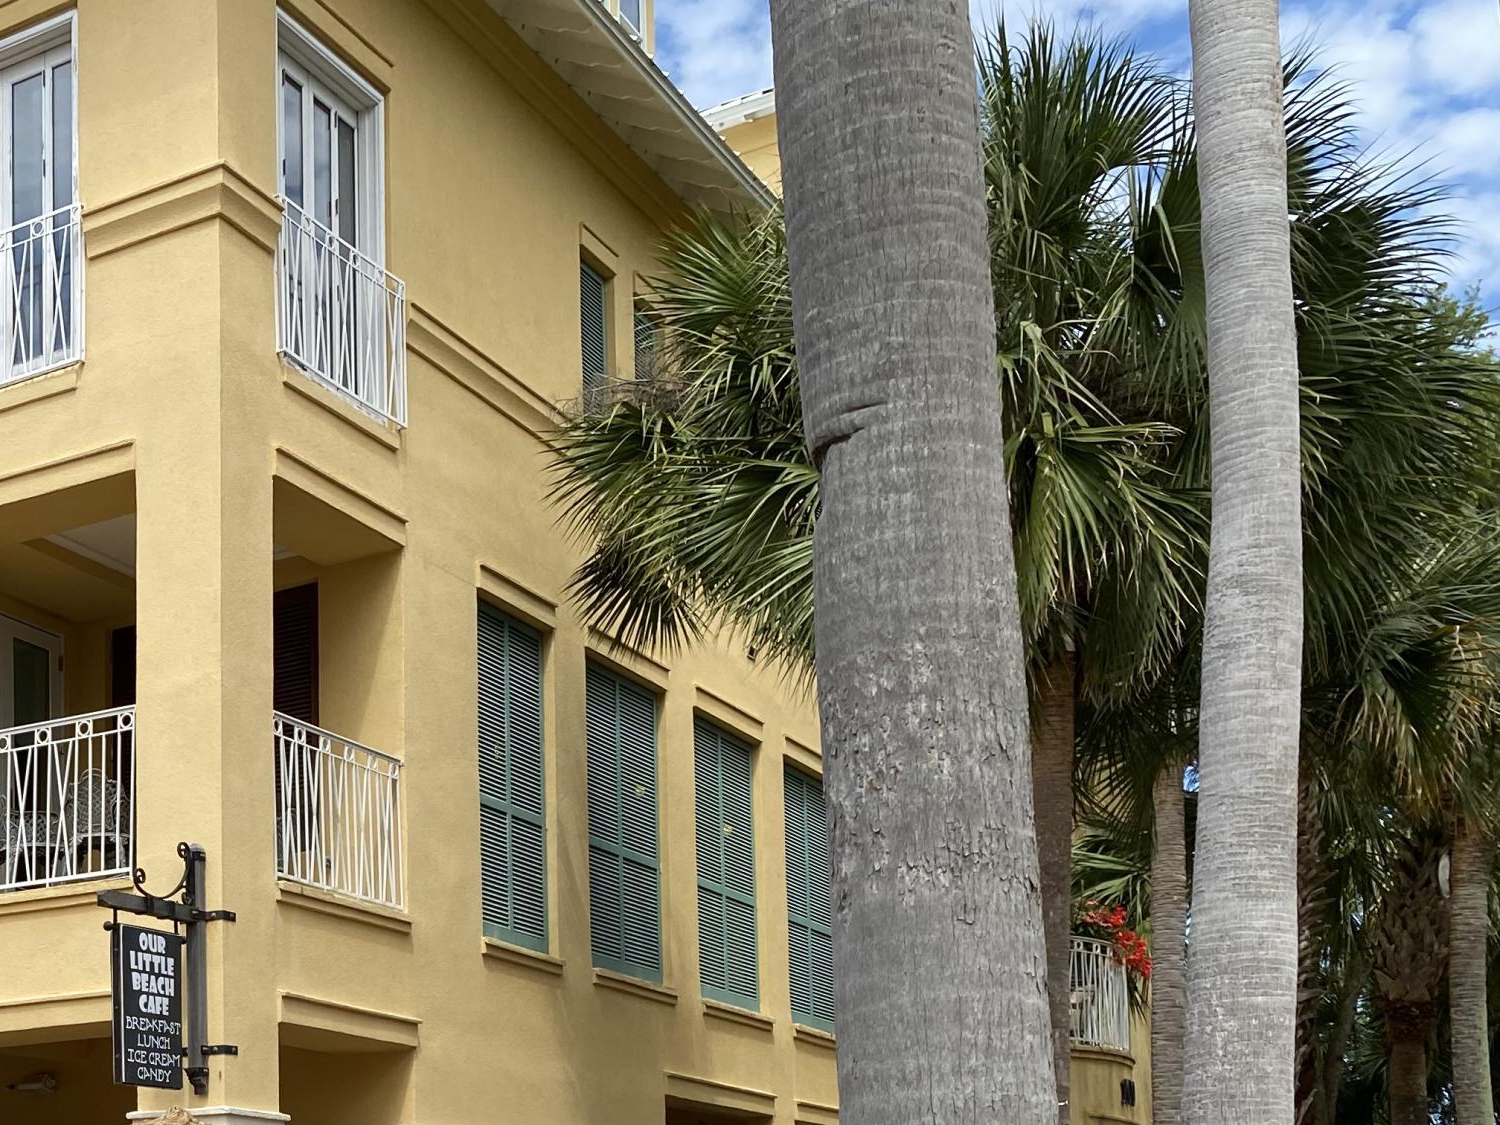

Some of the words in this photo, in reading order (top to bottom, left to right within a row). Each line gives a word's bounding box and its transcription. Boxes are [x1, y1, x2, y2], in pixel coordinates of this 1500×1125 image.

[138, 932, 166, 954] OUR
[130, 950, 175, 976] LITTLE
[131, 973, 175, 997] BEACH
[138, 995, 170, 1016] CAFE
[126, 1015, 181, 1035] BREAKFAST
[137, 1035, 171, 1050] LUNCH
[127, 1048, 146, 1064] ICE
[148, 1053, 181, 1068] CREAM
[137, 1066, 172, 1083] CANDY
